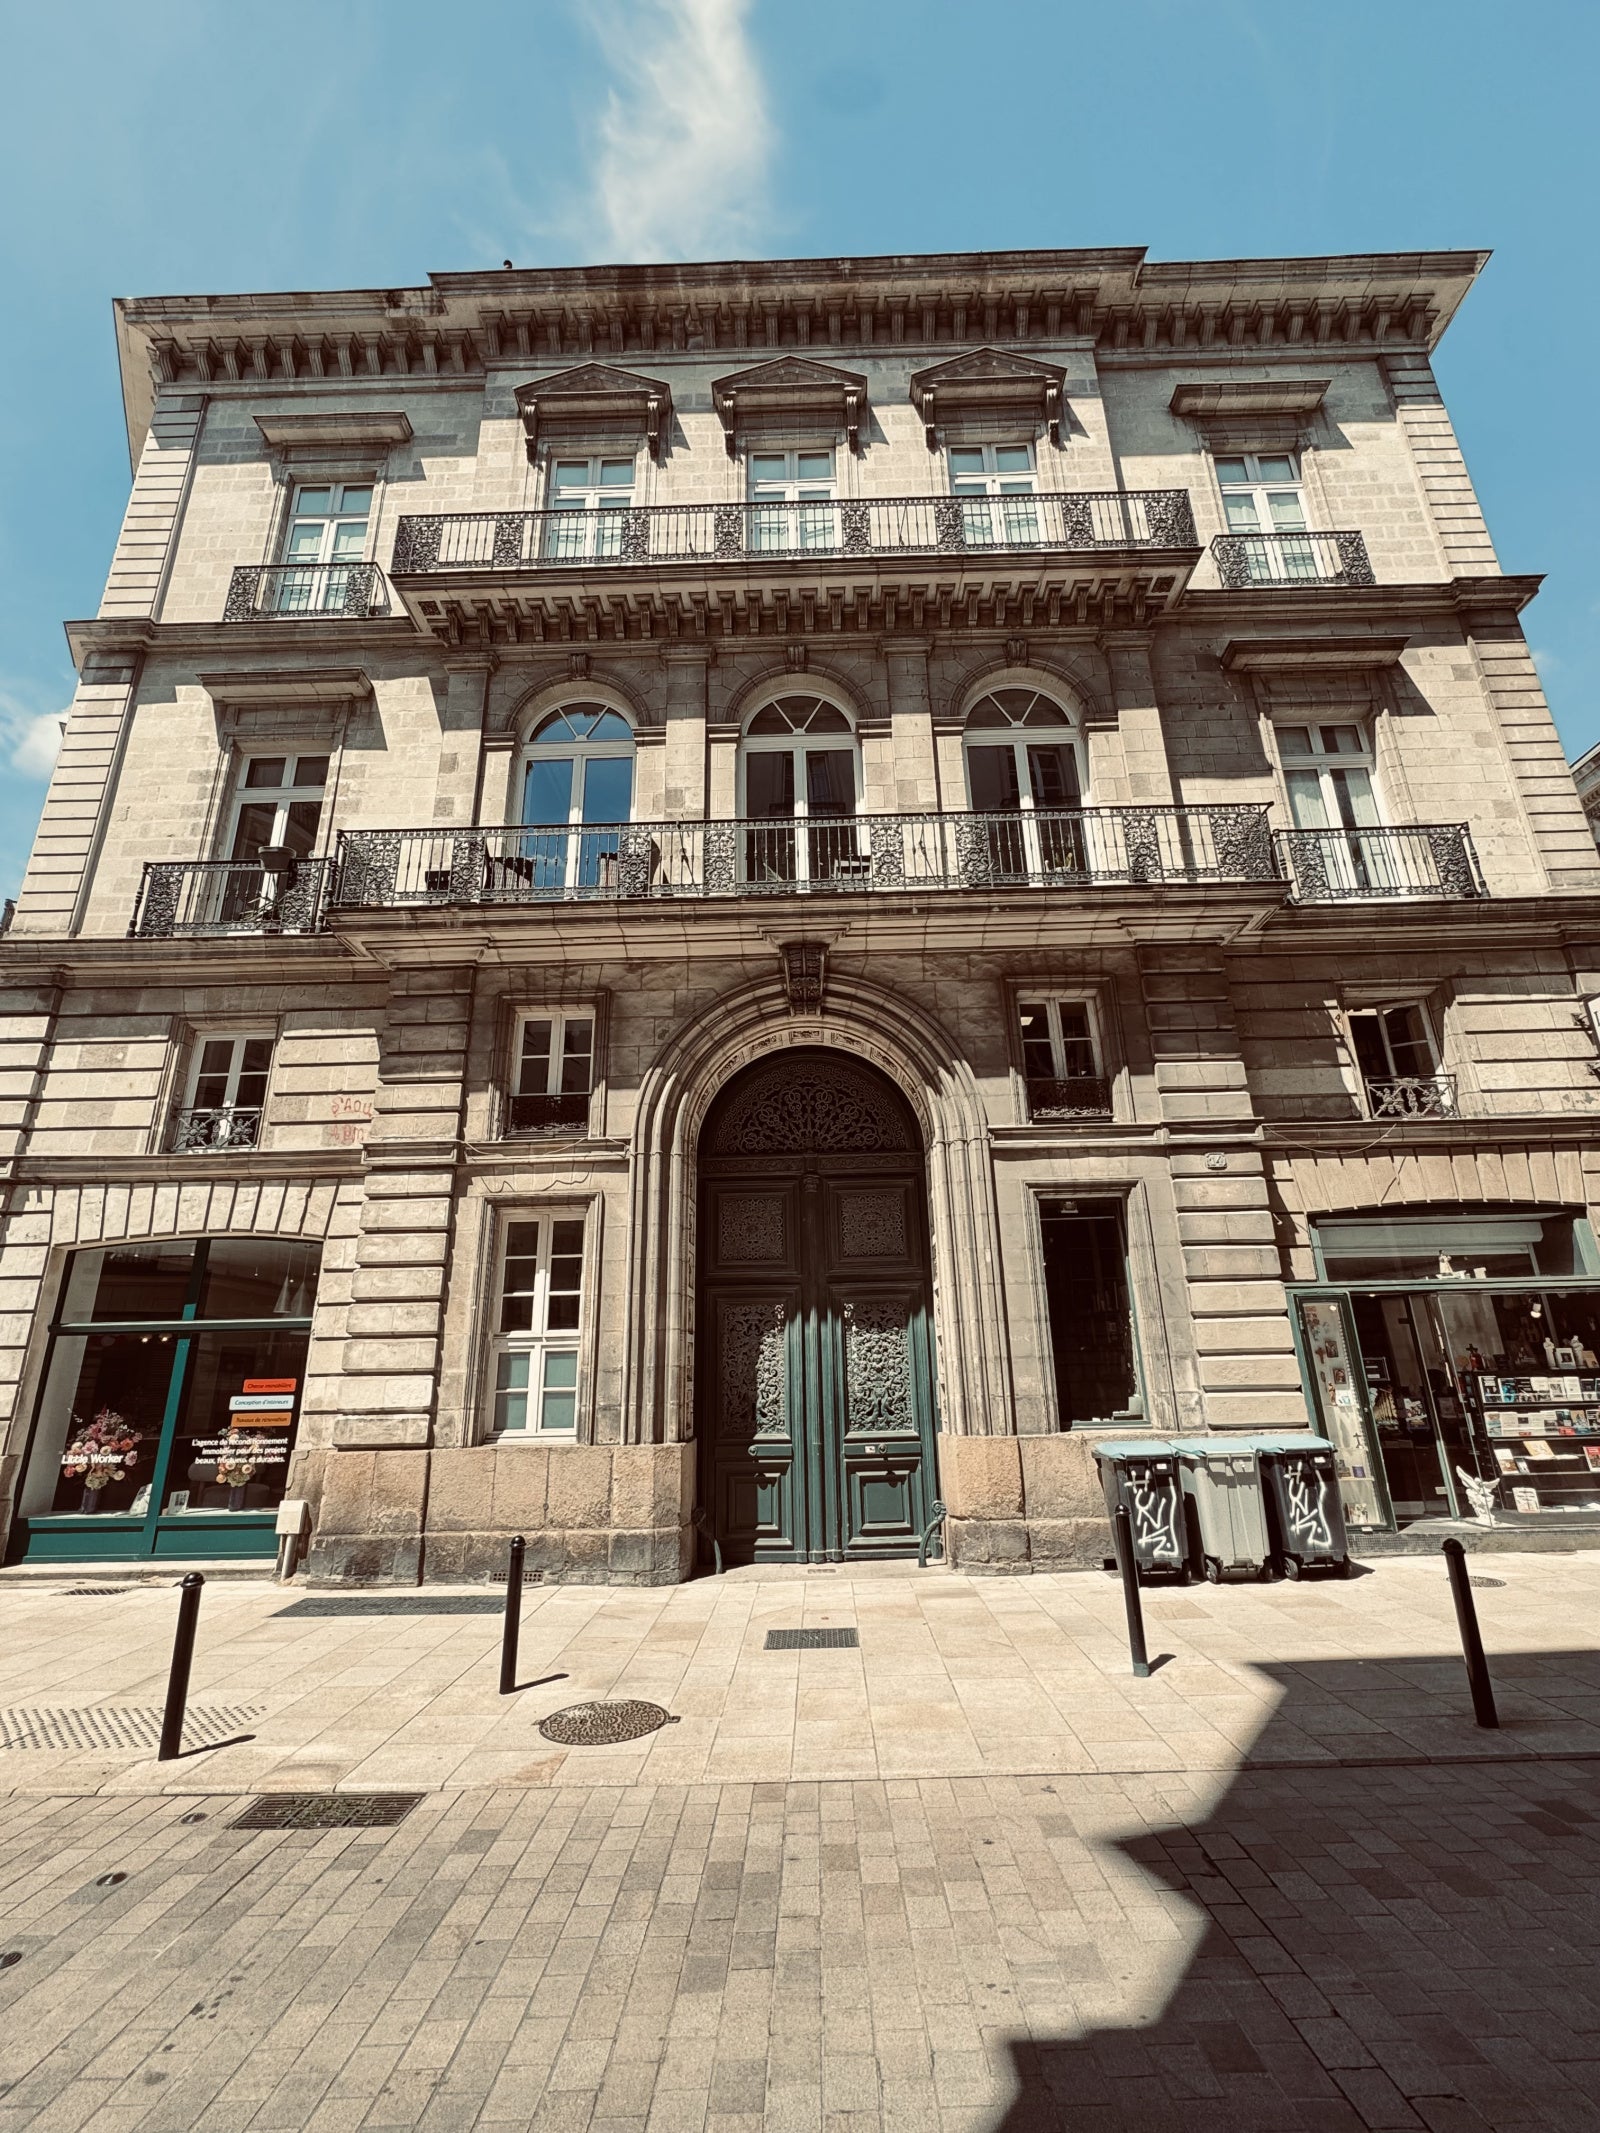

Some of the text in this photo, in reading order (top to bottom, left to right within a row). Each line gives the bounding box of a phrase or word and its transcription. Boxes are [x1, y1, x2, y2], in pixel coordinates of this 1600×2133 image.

[192, 1439, 218, 1447] L'agence
[201, 1446, 287, 1455] immobilier pour des projets
[61, 1454, 124, 1465] Little Worker
[194, 1457, 216, 1465] beaux,
[256, 1455, 285, 1463] durables.
